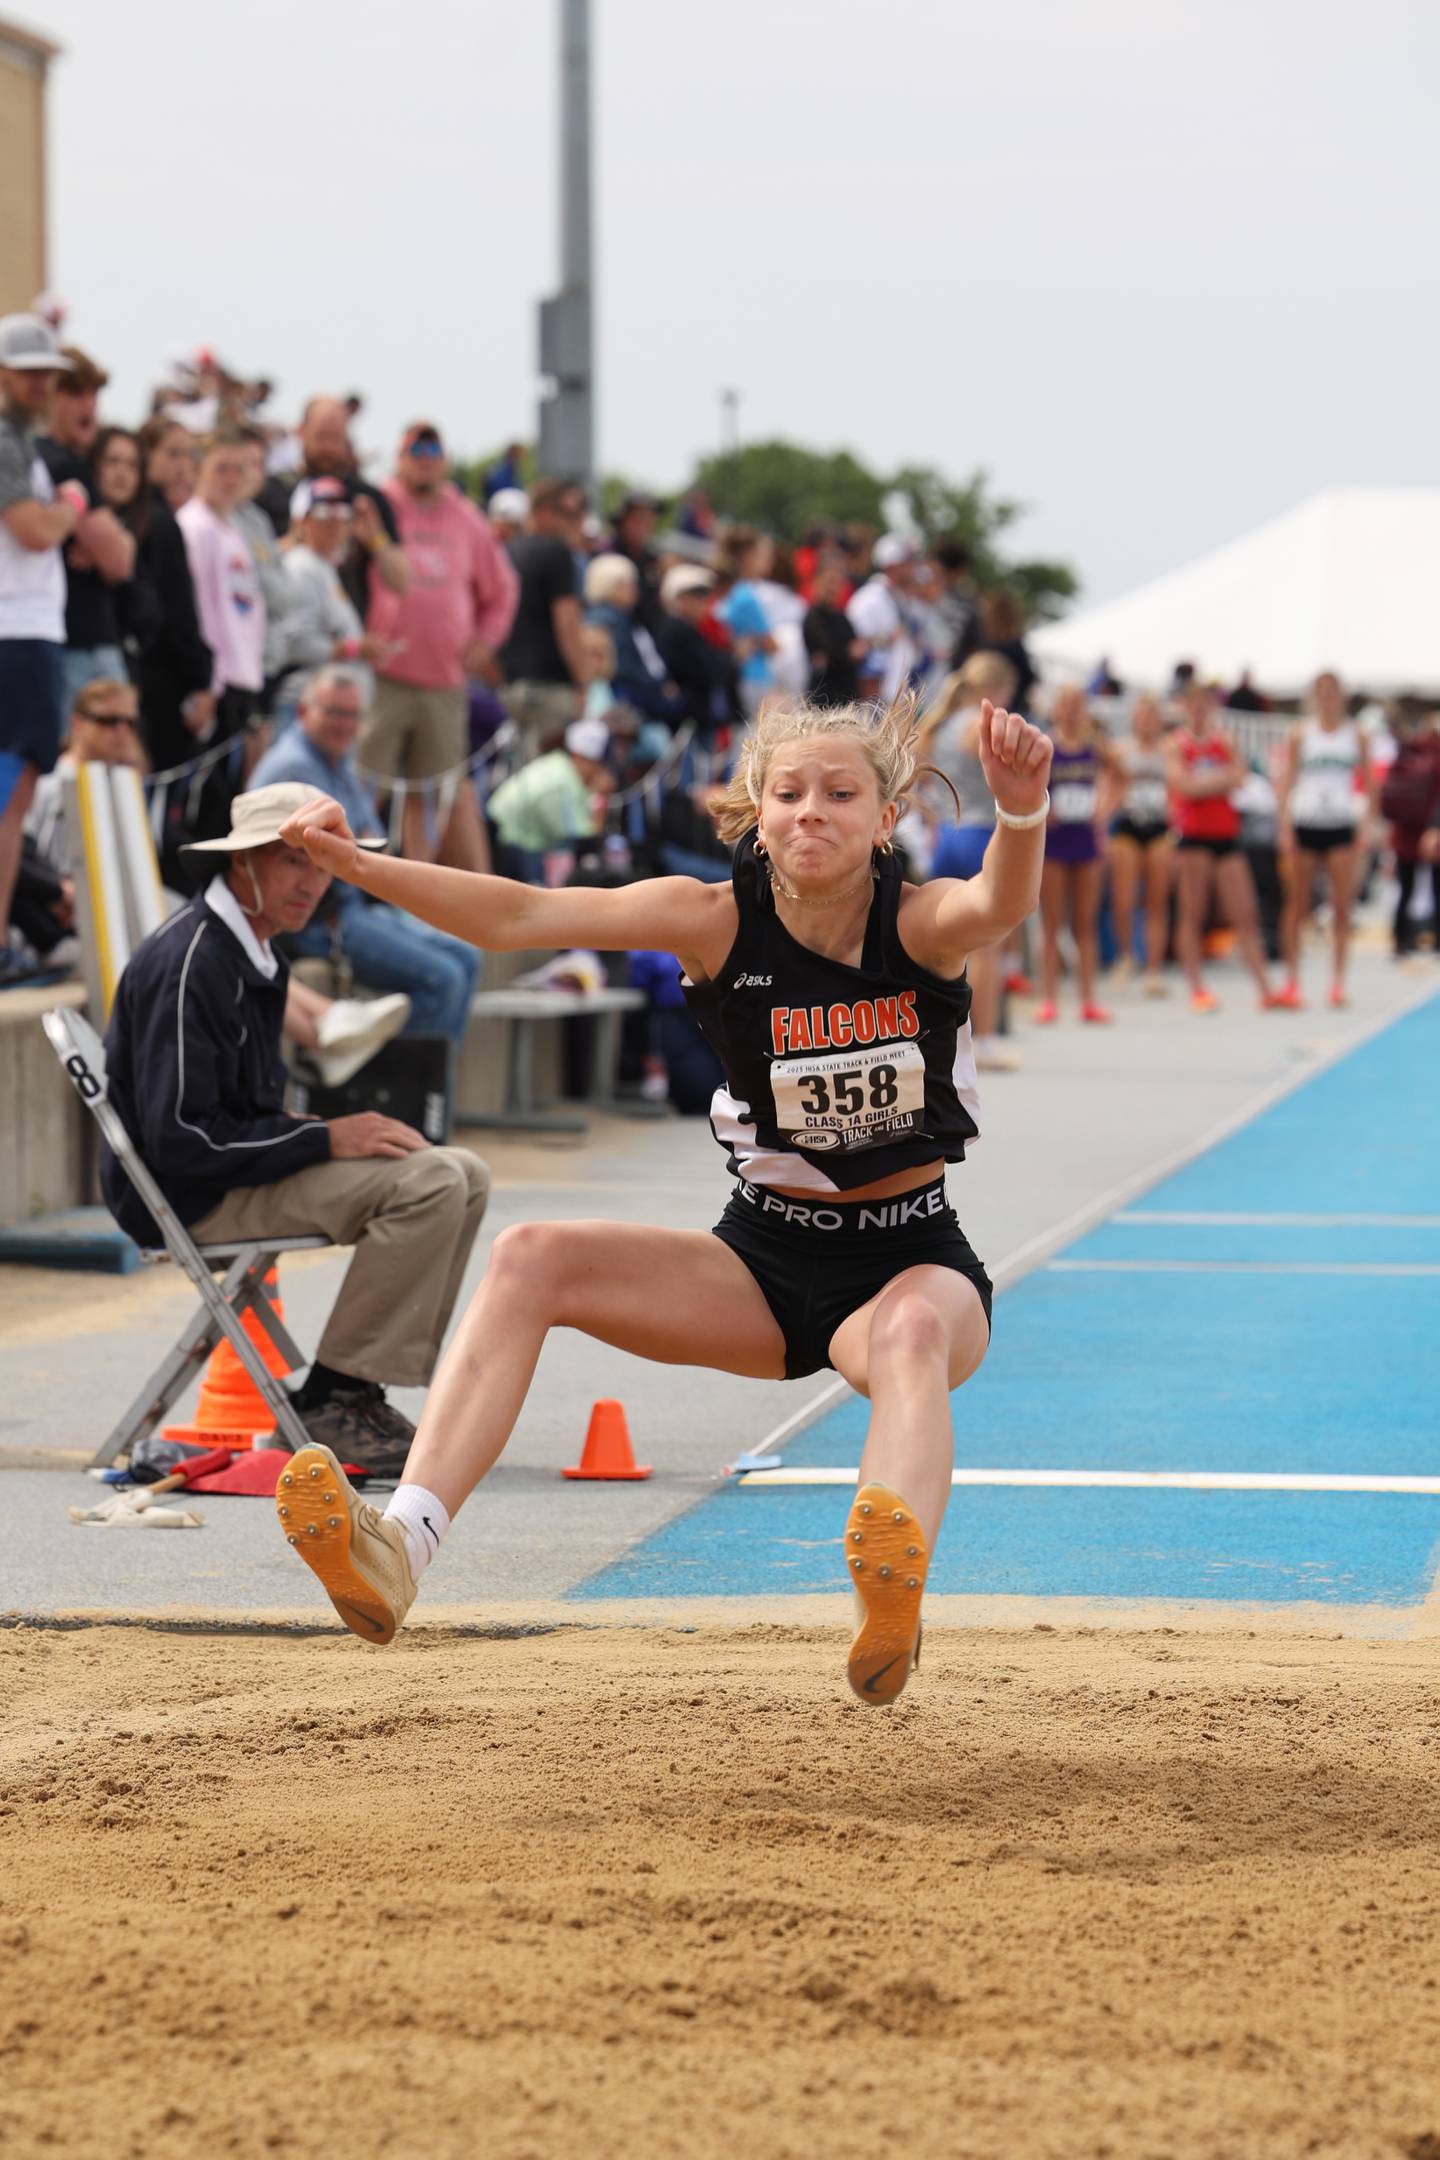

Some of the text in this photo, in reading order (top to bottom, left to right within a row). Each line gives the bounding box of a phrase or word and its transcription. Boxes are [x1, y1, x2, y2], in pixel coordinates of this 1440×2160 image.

[771, 990, 921, 1056] FALCONS
[67, 1055, 101, 1098] 8
[822, 1063, 841, 1072] STATE
[843, 1059, 862, 1069] TRACK
[870, 1055, 888, 1065] FIELD
[889, 1050, 905, 1059] MEET
[797, 1064, 899, 1116] 358
[805, 1106, 898, 1129] CLASS 1A GIRLS
[842, 1125, 873, 1144] TRACK
[886, 1112, 914, 1131] FIELD
[762, 1194, 843, 1231] PRO
[858, 1186, 944, 1231] NIKE
